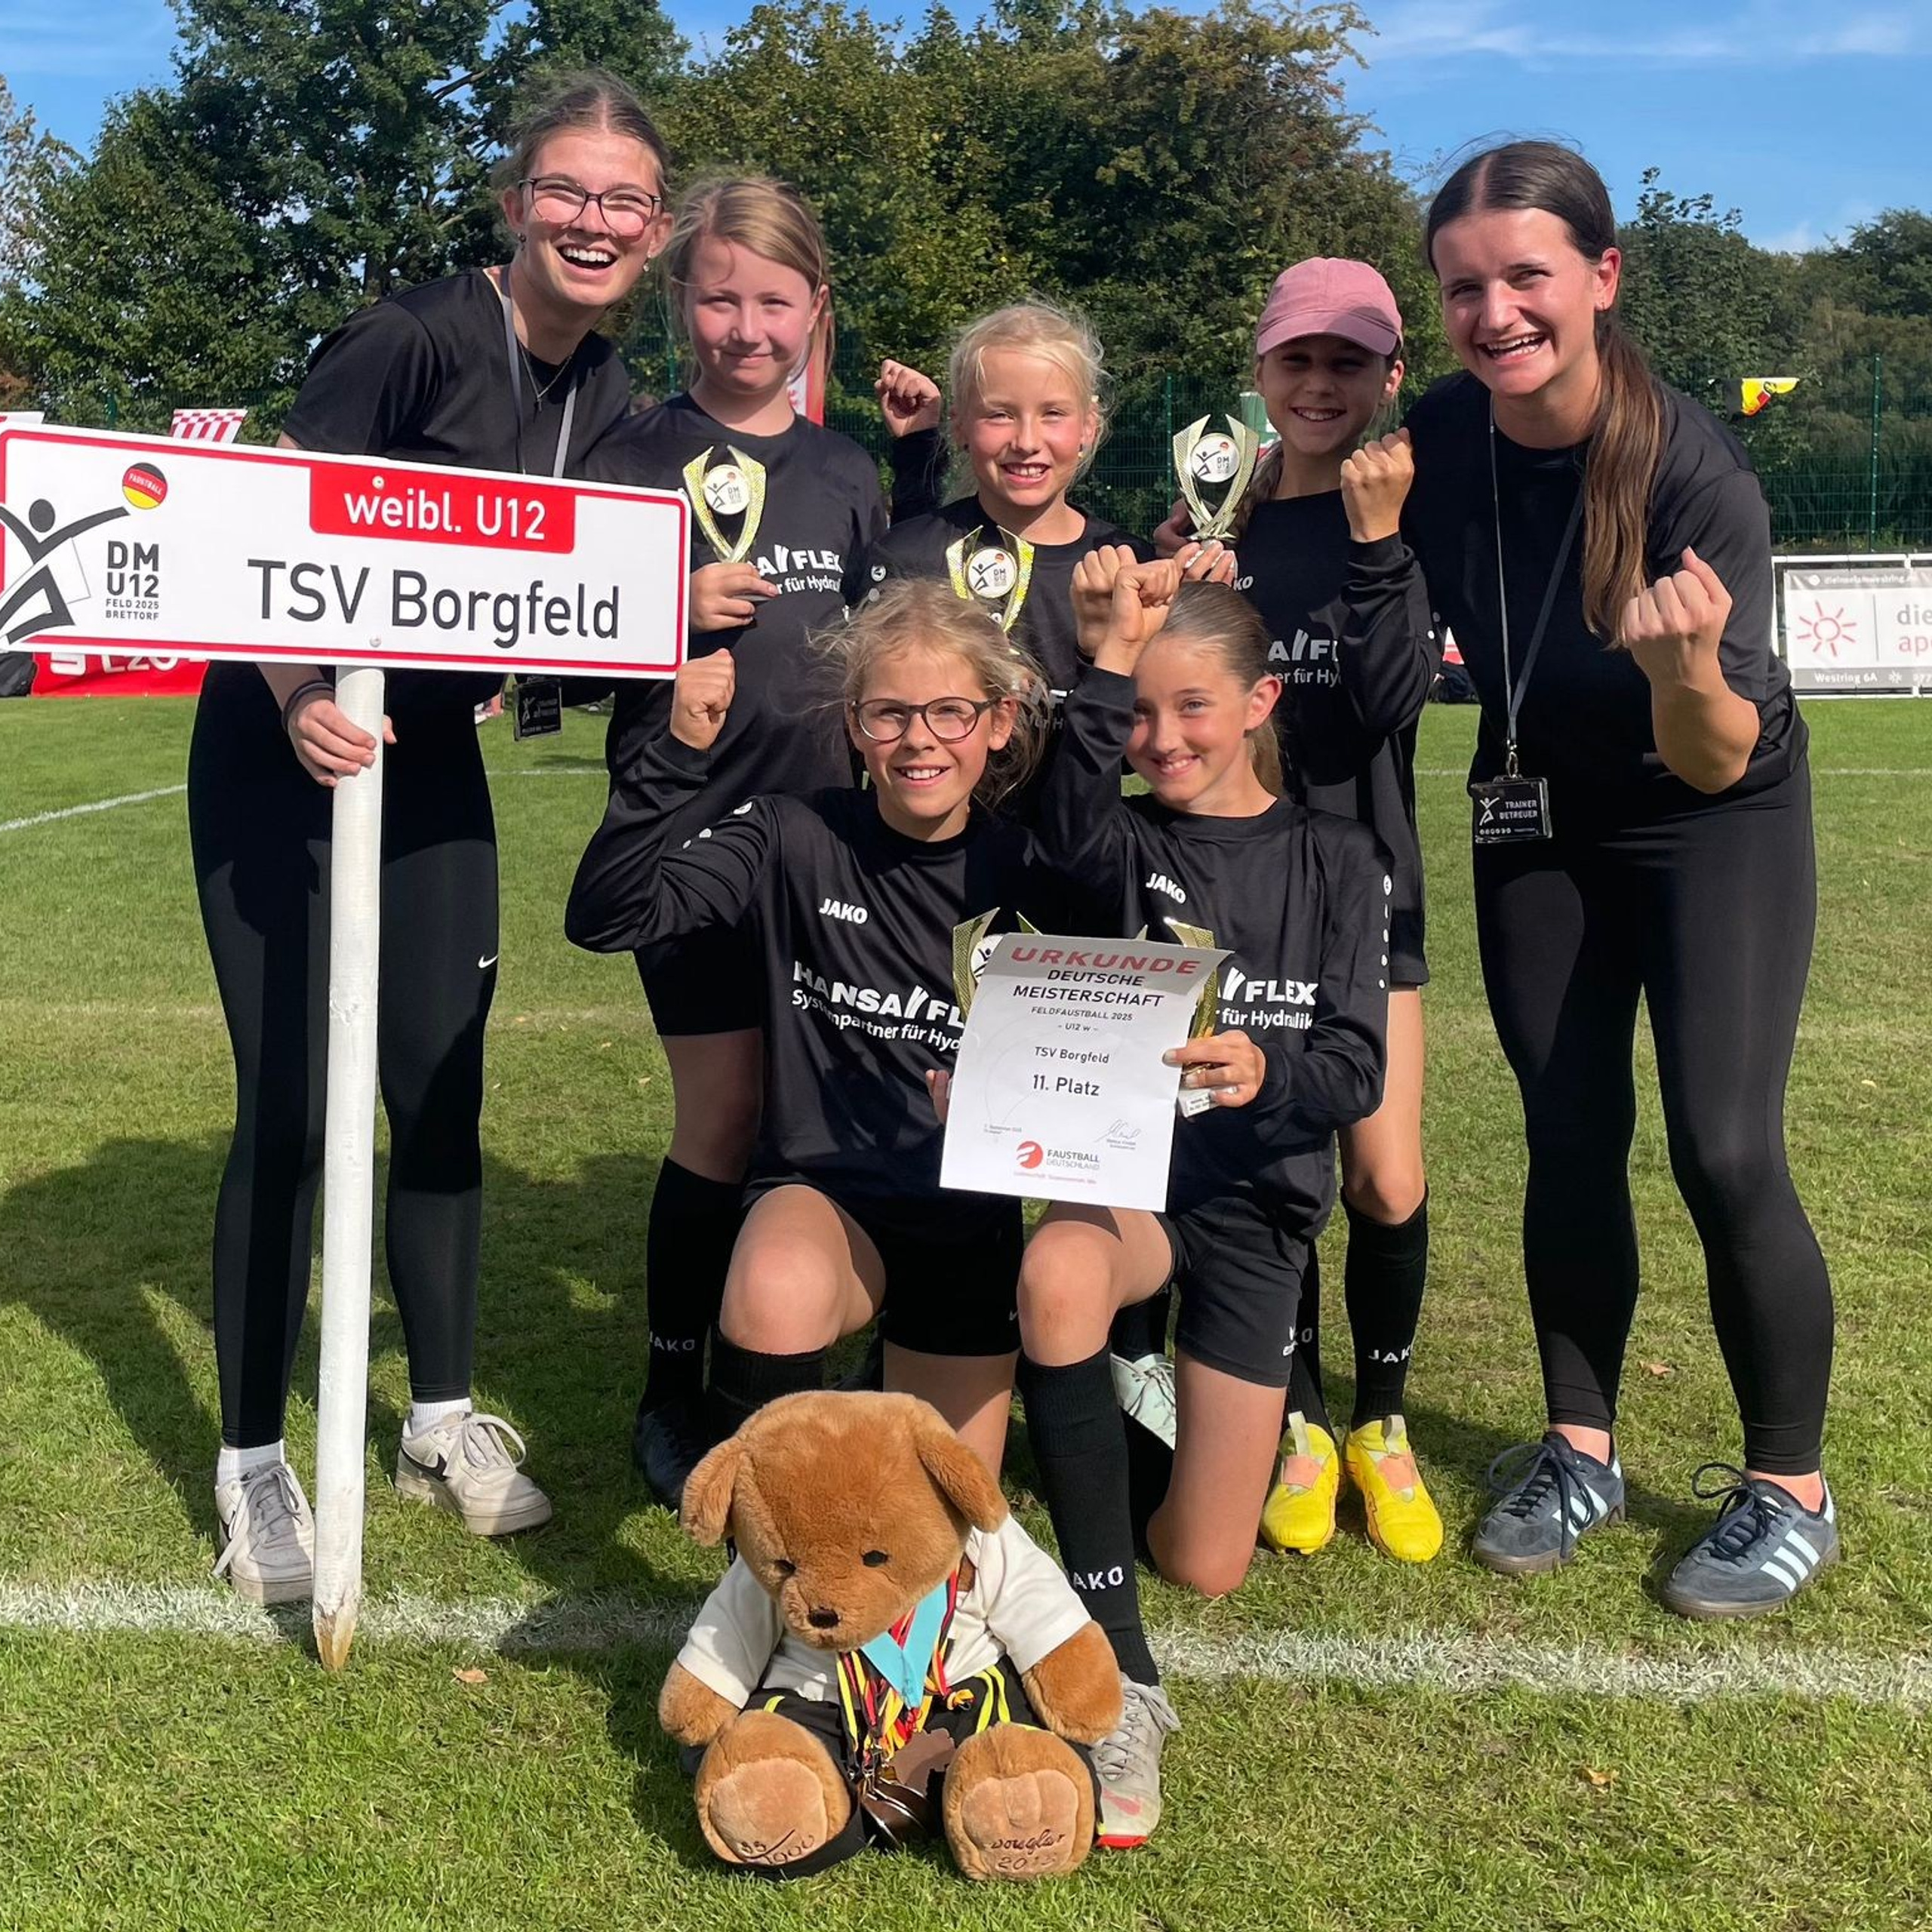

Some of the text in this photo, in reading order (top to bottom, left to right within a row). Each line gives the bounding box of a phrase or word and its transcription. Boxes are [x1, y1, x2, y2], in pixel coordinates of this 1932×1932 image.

[343, 488, 546, 540] weibl. U12
[107, 540, 159, 572] DM
[106, 571, 159, 598] U12
[785, 577, 805, 592] für
[1233, 576, 1254, 591] KO
[105, 598, 159, 610] FELD 2025
[248, 558, 620, 649] TSV Borgfeld
[105, 610, 159, 621] BRETTORF
[1897, 604, 1932, 625] die
[1899, 635, 1932, 657] ap
[1294, 668, 1314, 684] für
[1505, 800, 1537, 809] TRAINER
[1499, 810, 1537, 820] BETREUER
[1146, 872, 1187, 904] JAKO
[818, 898, 868, 924] JAKO
[1011, 946, 1201, 974] URKUNDE
[1048, 969, 1146, 986] DEUTSCHE
[1013, 984, 1164, 1008] MEISTERSCHAFT
[1031, 1006, 1133, 1021] FELDFAUSTBALL 2025
[1222, 1008, 1248, 1026] für
[901, 1023, 928, 1040] für
[1065, 1023, 1081, 1031] U12
[1035, 1046, 1110, 1064] TSV Borgfeld
[1033, 1074, 1100, 1097] 11. Platz
[1046, 1158, 1100, 1171] DEUTSCHLAND
[1047, 1149, 1100, 1163] FAUSTBALL
[1368, 1344, 1413, 1364] JAK
[1072, 1566, 1124, 1590] AKO
